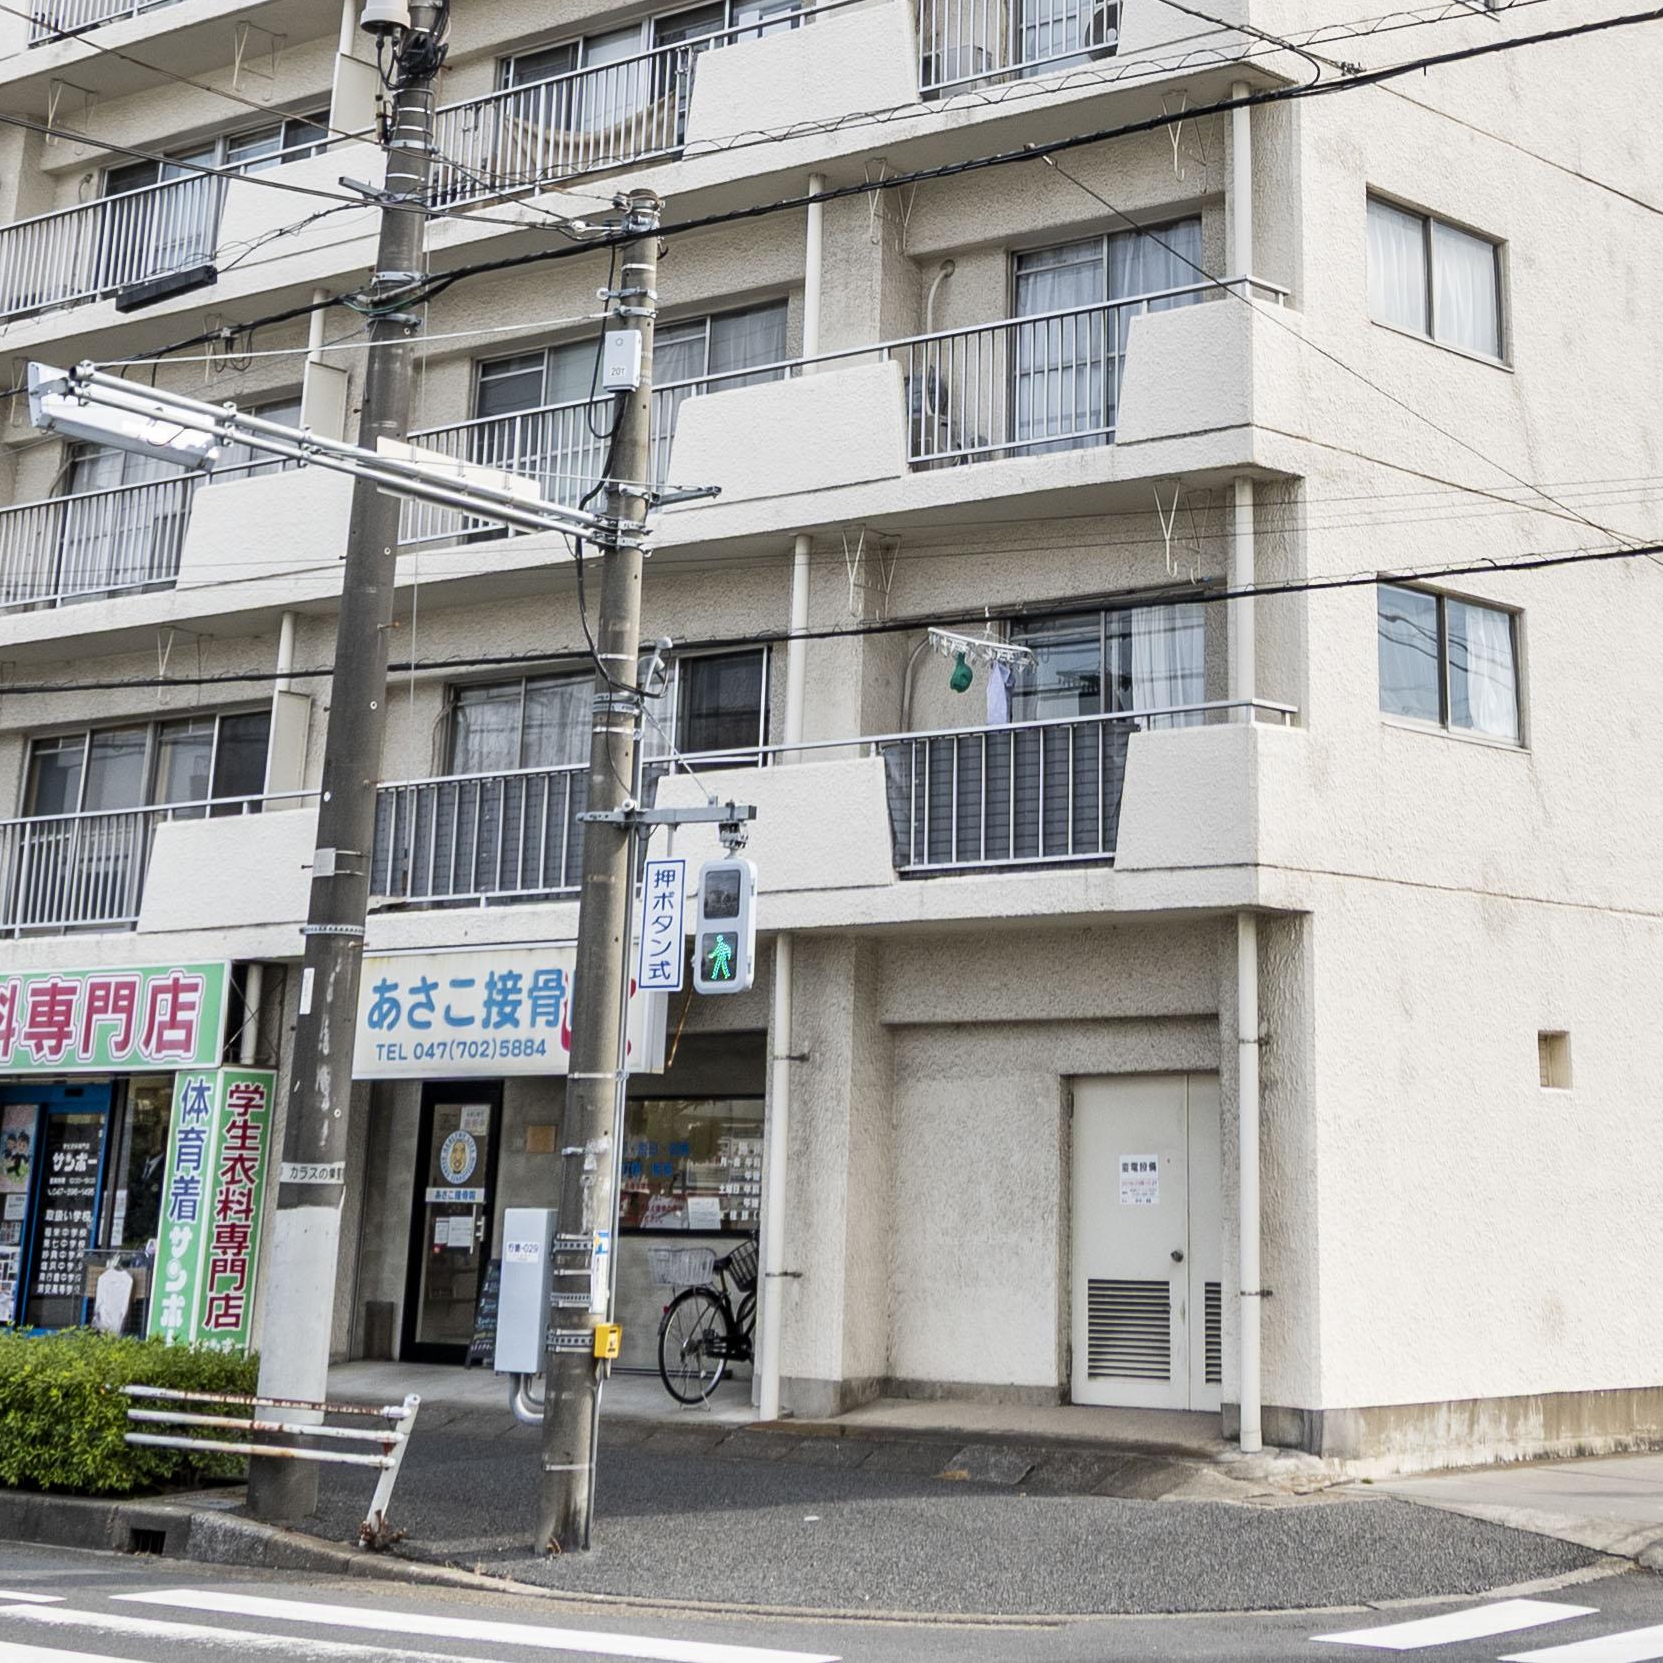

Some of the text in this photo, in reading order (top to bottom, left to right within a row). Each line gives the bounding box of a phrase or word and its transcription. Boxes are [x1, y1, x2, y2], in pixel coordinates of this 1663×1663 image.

[648, 868, 676, 980] 押ボタン式
[367, 968, 575, 1032] あさこ接骨
[375, 1039, 548, 1061] TEL 047(702)5884
[169, 1078, 212, 1224] 体育着
[203, 1082, 266, 1332] 学生衣料専門店
